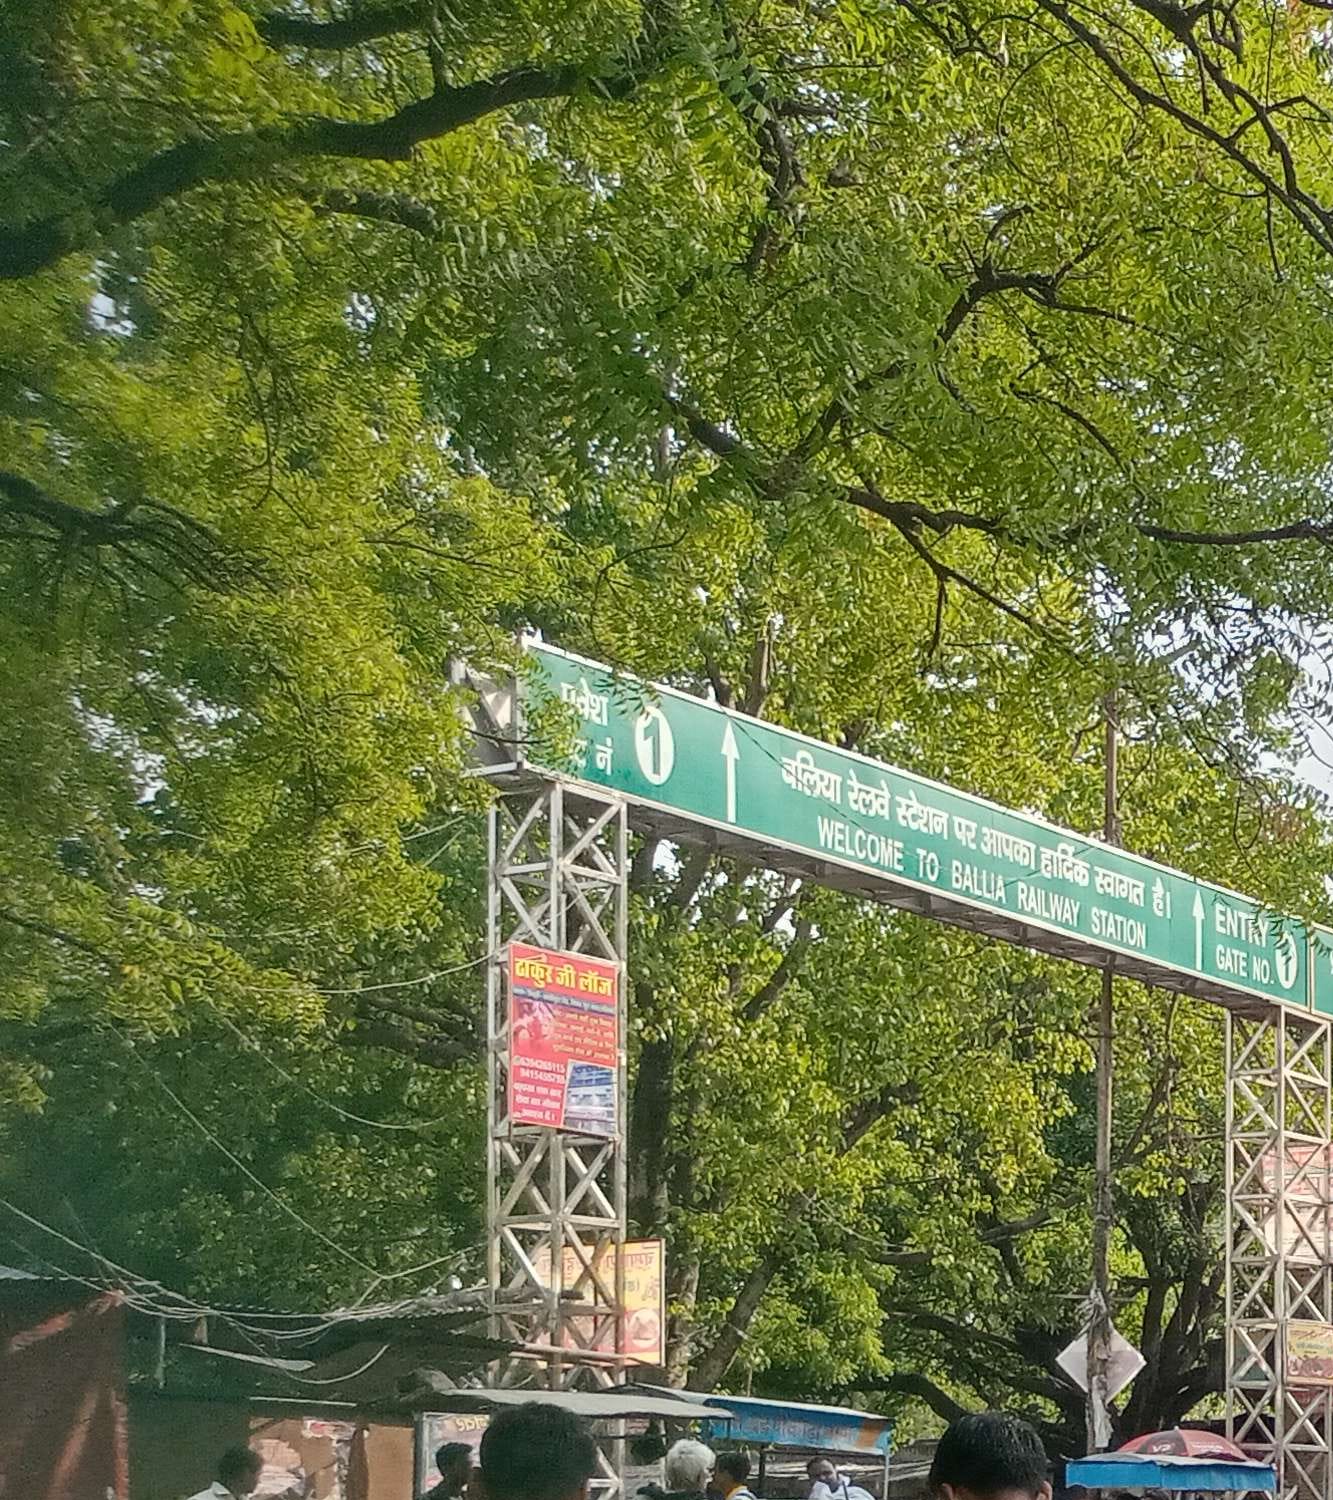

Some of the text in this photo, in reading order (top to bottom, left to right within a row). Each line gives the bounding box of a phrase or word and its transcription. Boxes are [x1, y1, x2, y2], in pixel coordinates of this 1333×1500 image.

[847, 769, 891, 820] रेलवे
[895, 789, 949, 840] स्टेशन
[953, 814, 977, 850] पर
[981, 826, 1036, 870] आपका
[1040, 842, 1090, 887] हार्दिक
[1094, 865, 1145, 907] स्वागत
[817, 816, 1147, 949] WELCOME TO BALLIA RAILWAY STATION
[1215, 902, 1269, 948] ENTRY
[556, 965, 575, 988] जी
[579, 969, 613, 996] लॉज
[1216, 944, 1248, 977] GATE
